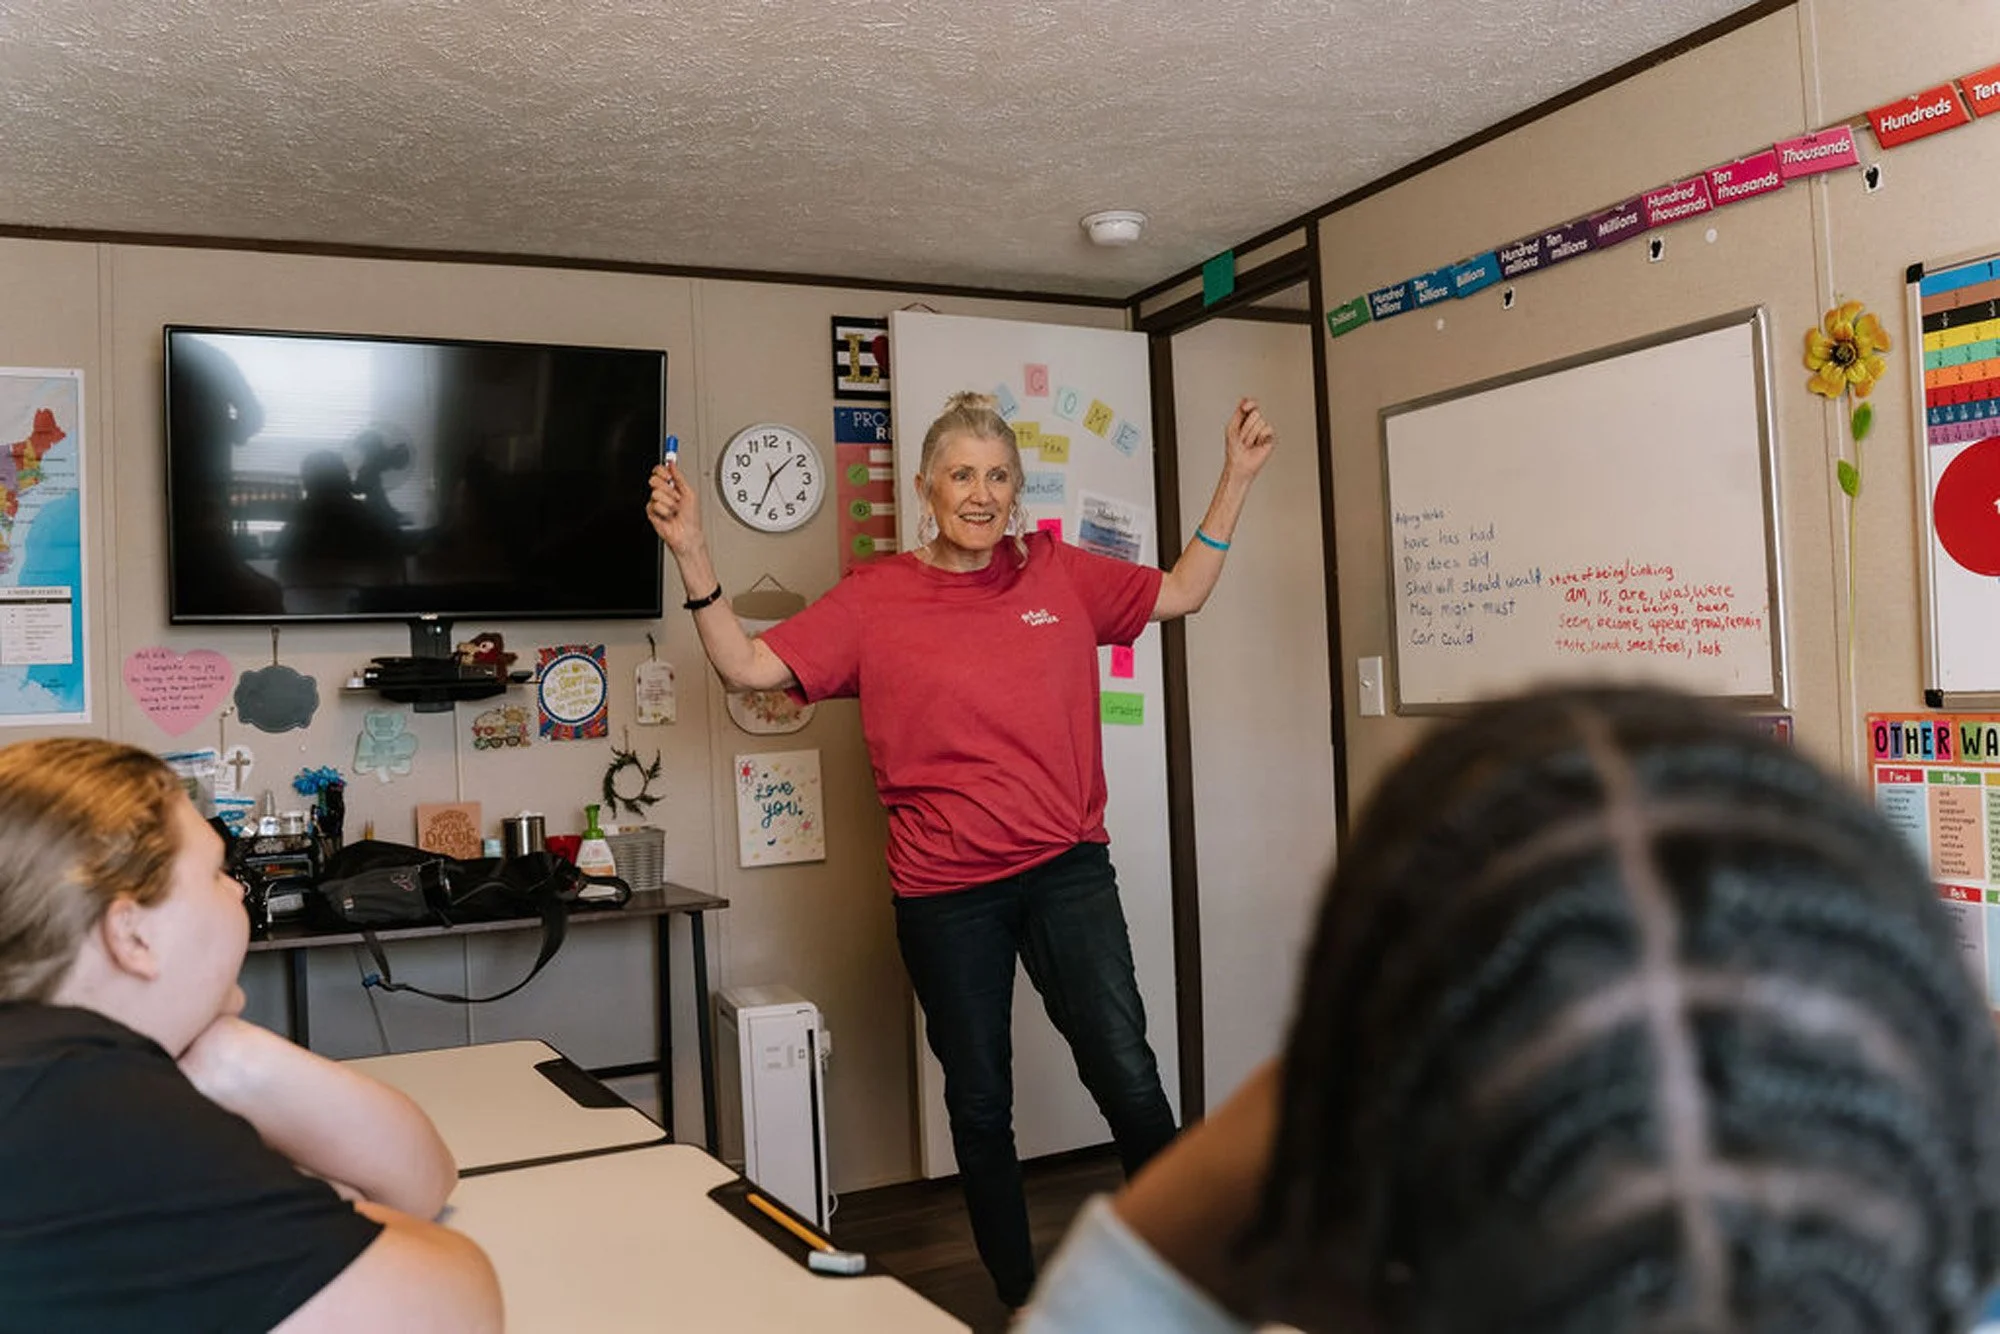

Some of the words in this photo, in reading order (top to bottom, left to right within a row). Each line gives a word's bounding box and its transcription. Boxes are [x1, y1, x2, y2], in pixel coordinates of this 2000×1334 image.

[1880, 99, 1952, 134] Hundreds
[1782, 137, 1850, 165] Thousands
[1712, 170, 1732, 185] Ten
[1717, 172, 1778, 199] thousands
[1648, 184, 1695, 208] Hundred
[1652, 198, 1707, 222] thousands
[1598, 212, 1638, 237] Millions
[1546, 233, 1563, 247] Ten
[1501, 239, 1540, 262] Hundred
[1551, 240, 1588, 260] millions
[1505, 256, 1539, 275] millions
[844, 333, 880, 384] L
[748, 440, 759, 453] 11
[763, 435, 779, 448] 12
[786, 441, 792, 453] 1
[735, 454, 751, 467] 10
[796, 454, 806, 467] 2
[731, 472, 741, 485] 9
[802, 472, 812, 485] 3
[737, 490, 748, 503] 8
[796, 490, 806, 502] 4
[751, 503, 762, 515] 7
[768, 508, 778, 520] 6
[785, 503, 796, 516] 5
[1462, 572, 1500, 593] should
[1874, 725, 1951, 754] OTHER
[1961, 726, 1999, 754] WA
